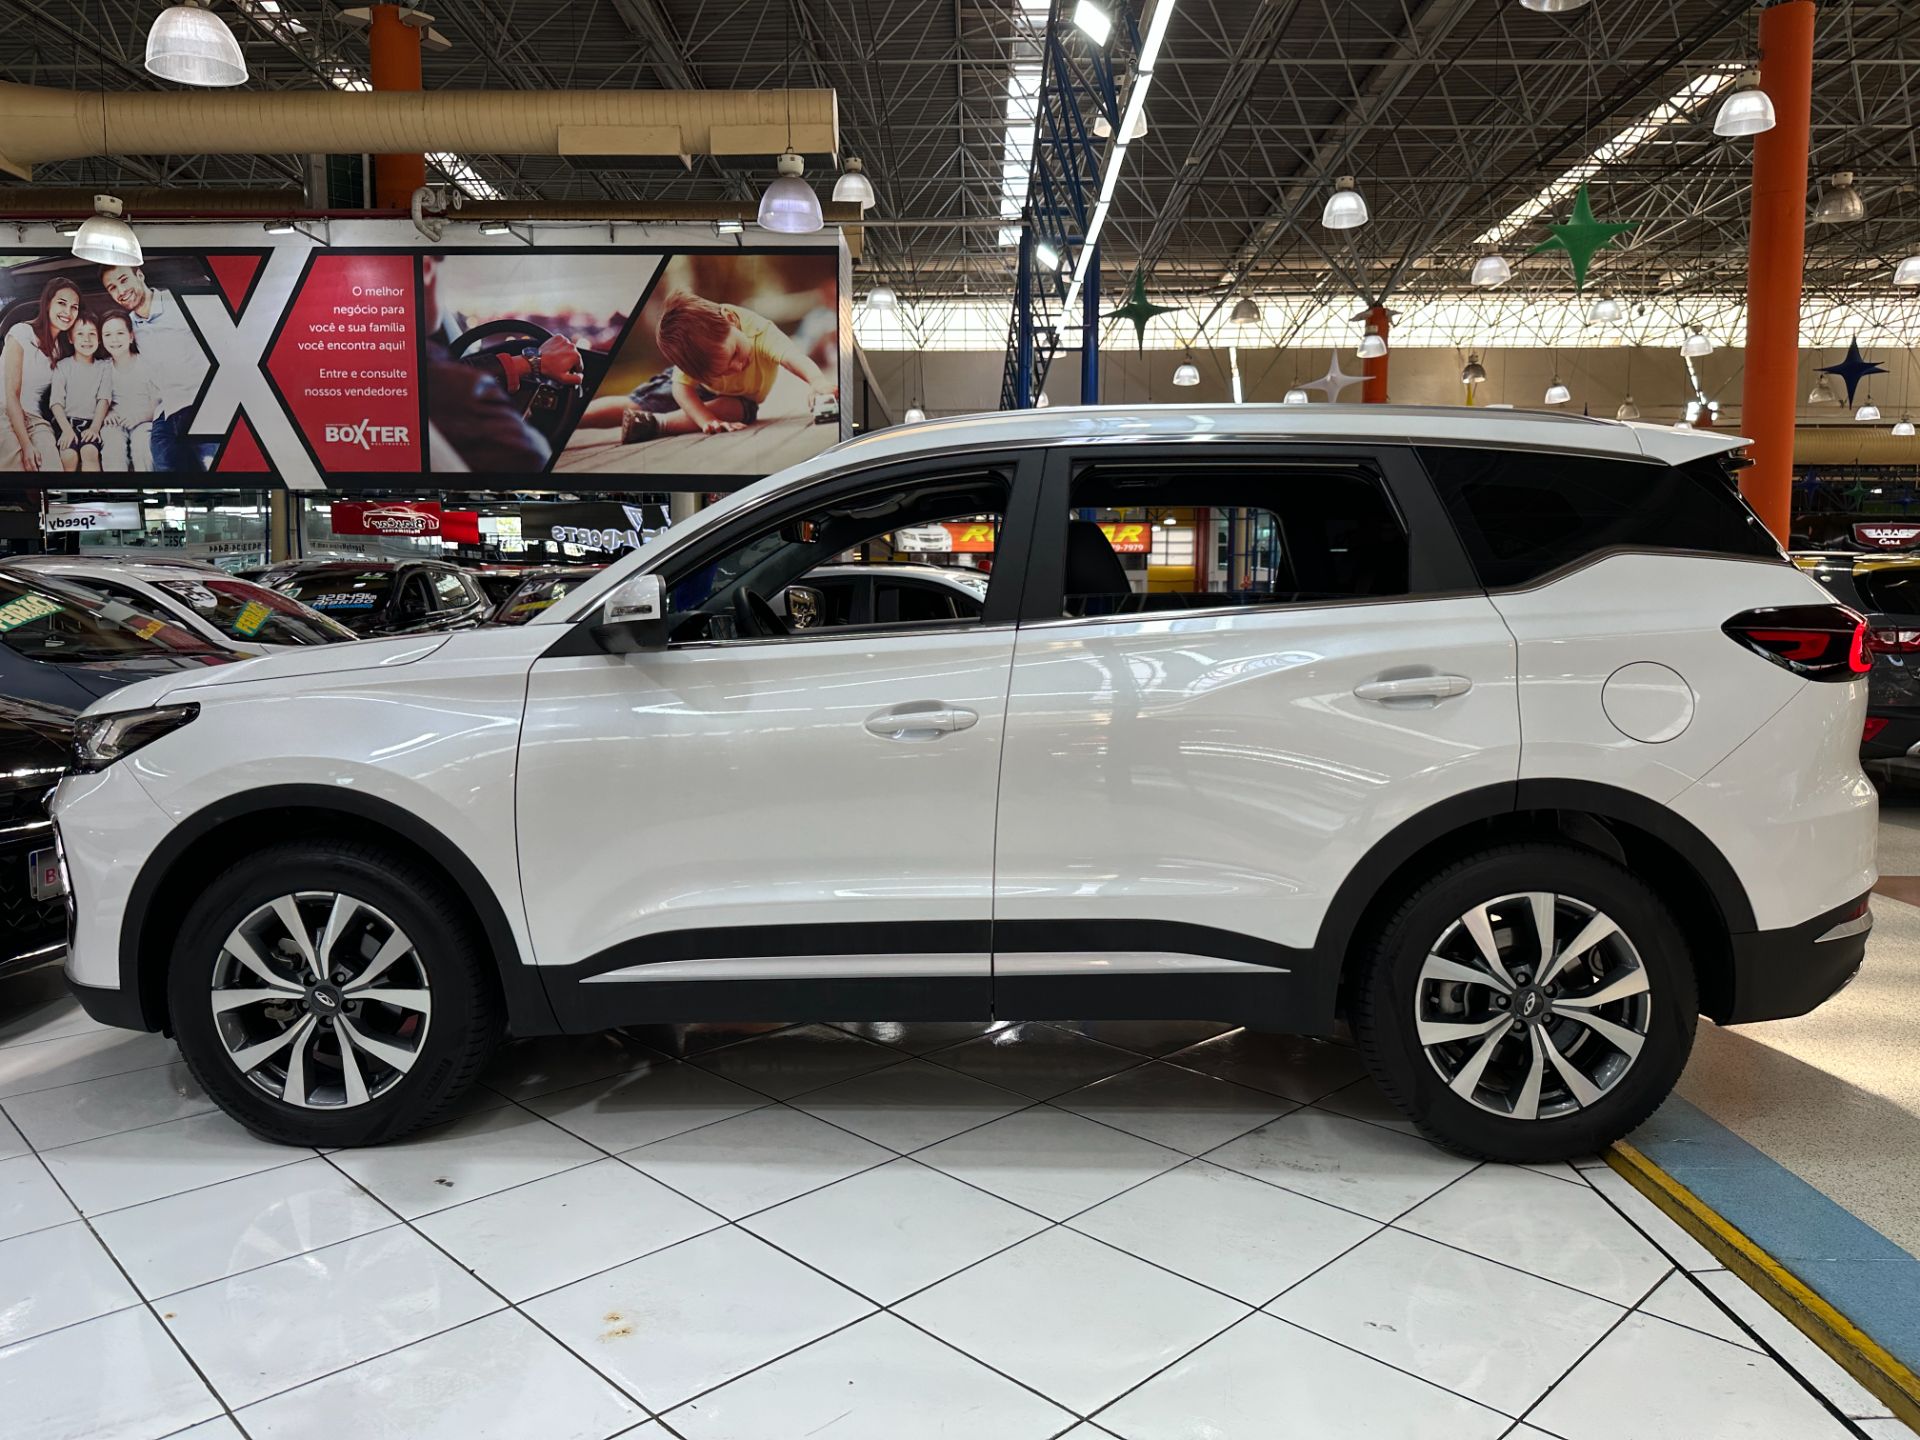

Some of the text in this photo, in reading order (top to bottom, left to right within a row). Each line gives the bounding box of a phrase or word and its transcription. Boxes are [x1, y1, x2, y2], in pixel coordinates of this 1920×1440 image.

[352, 286, 404, 296] O melhor
[333, 305, 405, 317] negócio para
[309, 322, 405, 333] você e sua família
[298, 340, 406, 352] você encontra aqui!
[319, 368, 408, 379] Entre e consulte
[304, 386, 408, 397] nossos vendedores
[325, 418, 410, 451] BOXTER
